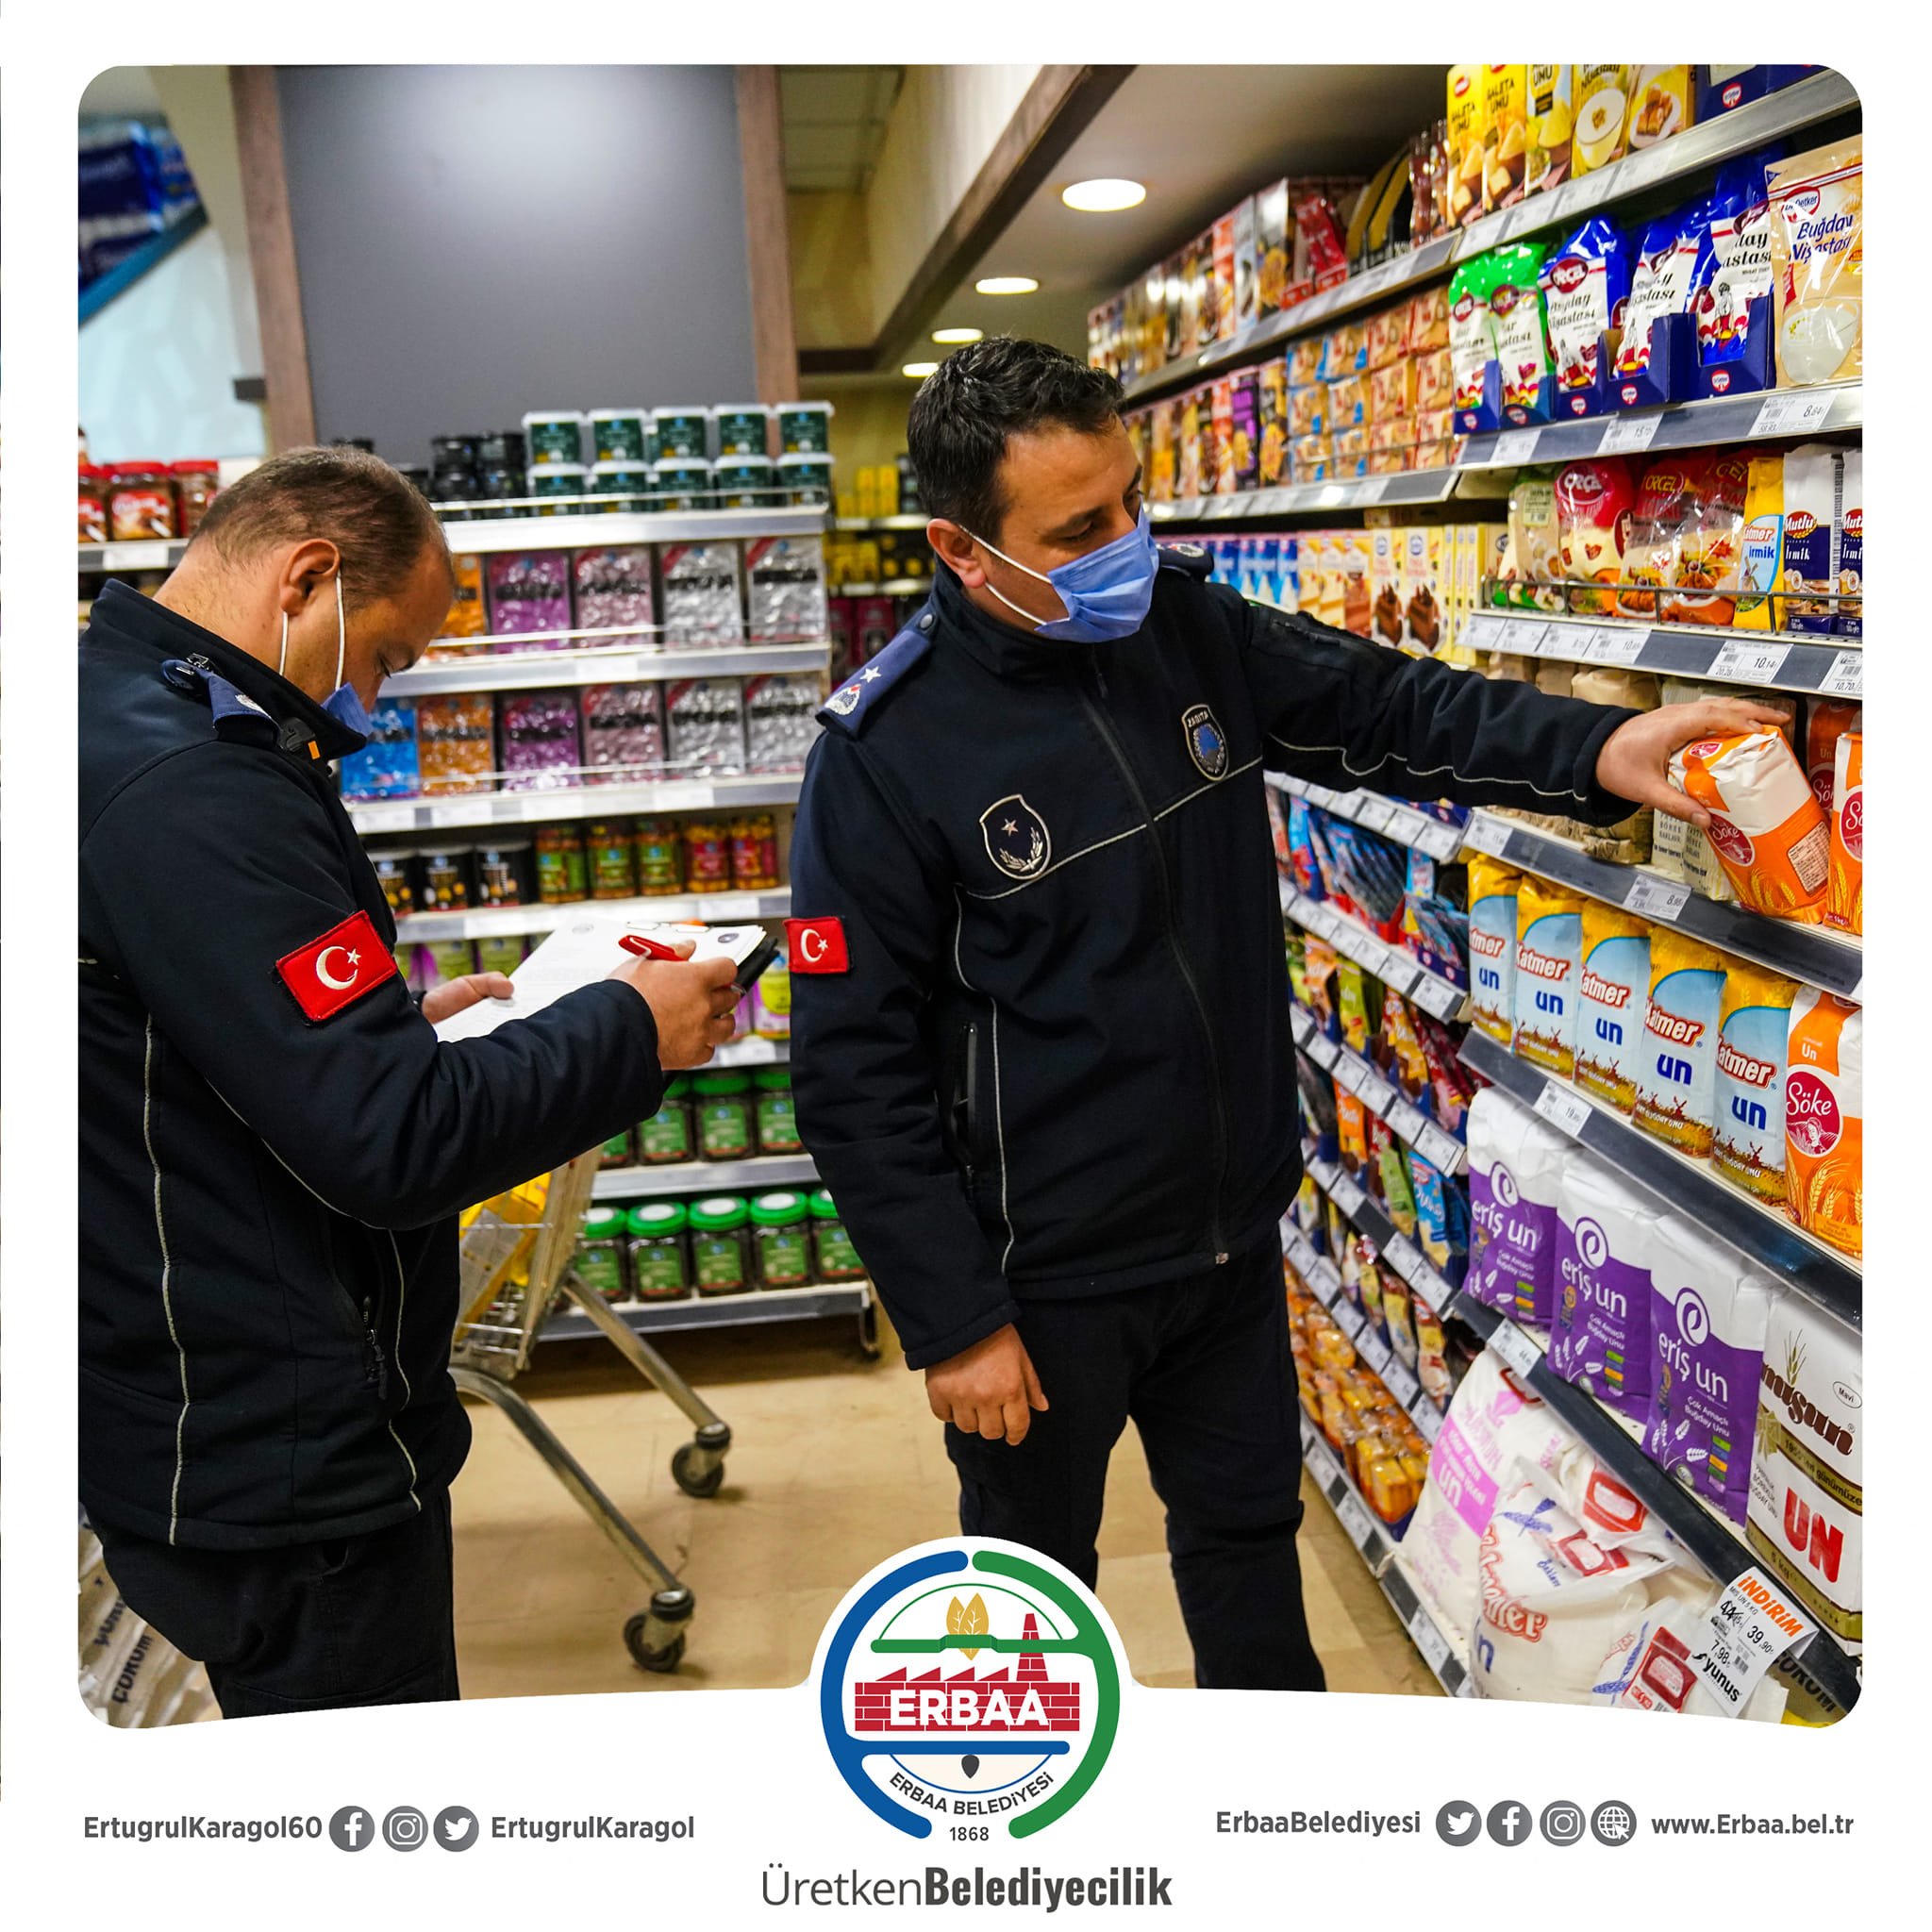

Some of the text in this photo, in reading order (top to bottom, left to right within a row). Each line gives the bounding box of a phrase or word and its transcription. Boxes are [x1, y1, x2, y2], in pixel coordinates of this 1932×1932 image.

[1478, 967, 1500, 991] un
[1535, 991, 1564, 1017] un
[1595, 1017, 1624, 1046] un
[1801, 1041, 1818, 1062] Un
[1657, 1053, 1692, 1087] un
[1731, 1094, 1767, 1131] un
[1786, 1082, 1832, 1117] Söke
[1472, 1199, 1505, 1240] eriş
[1507, 1219, 1538, 1252] un
[1562, 1257, 1627, 1319] eriş un
[1658, 1332, 1728, 1403] eriş un
[1784, 1487, 1844, 1584] UN
[1703, 1657, 1741, 1703] yunus
